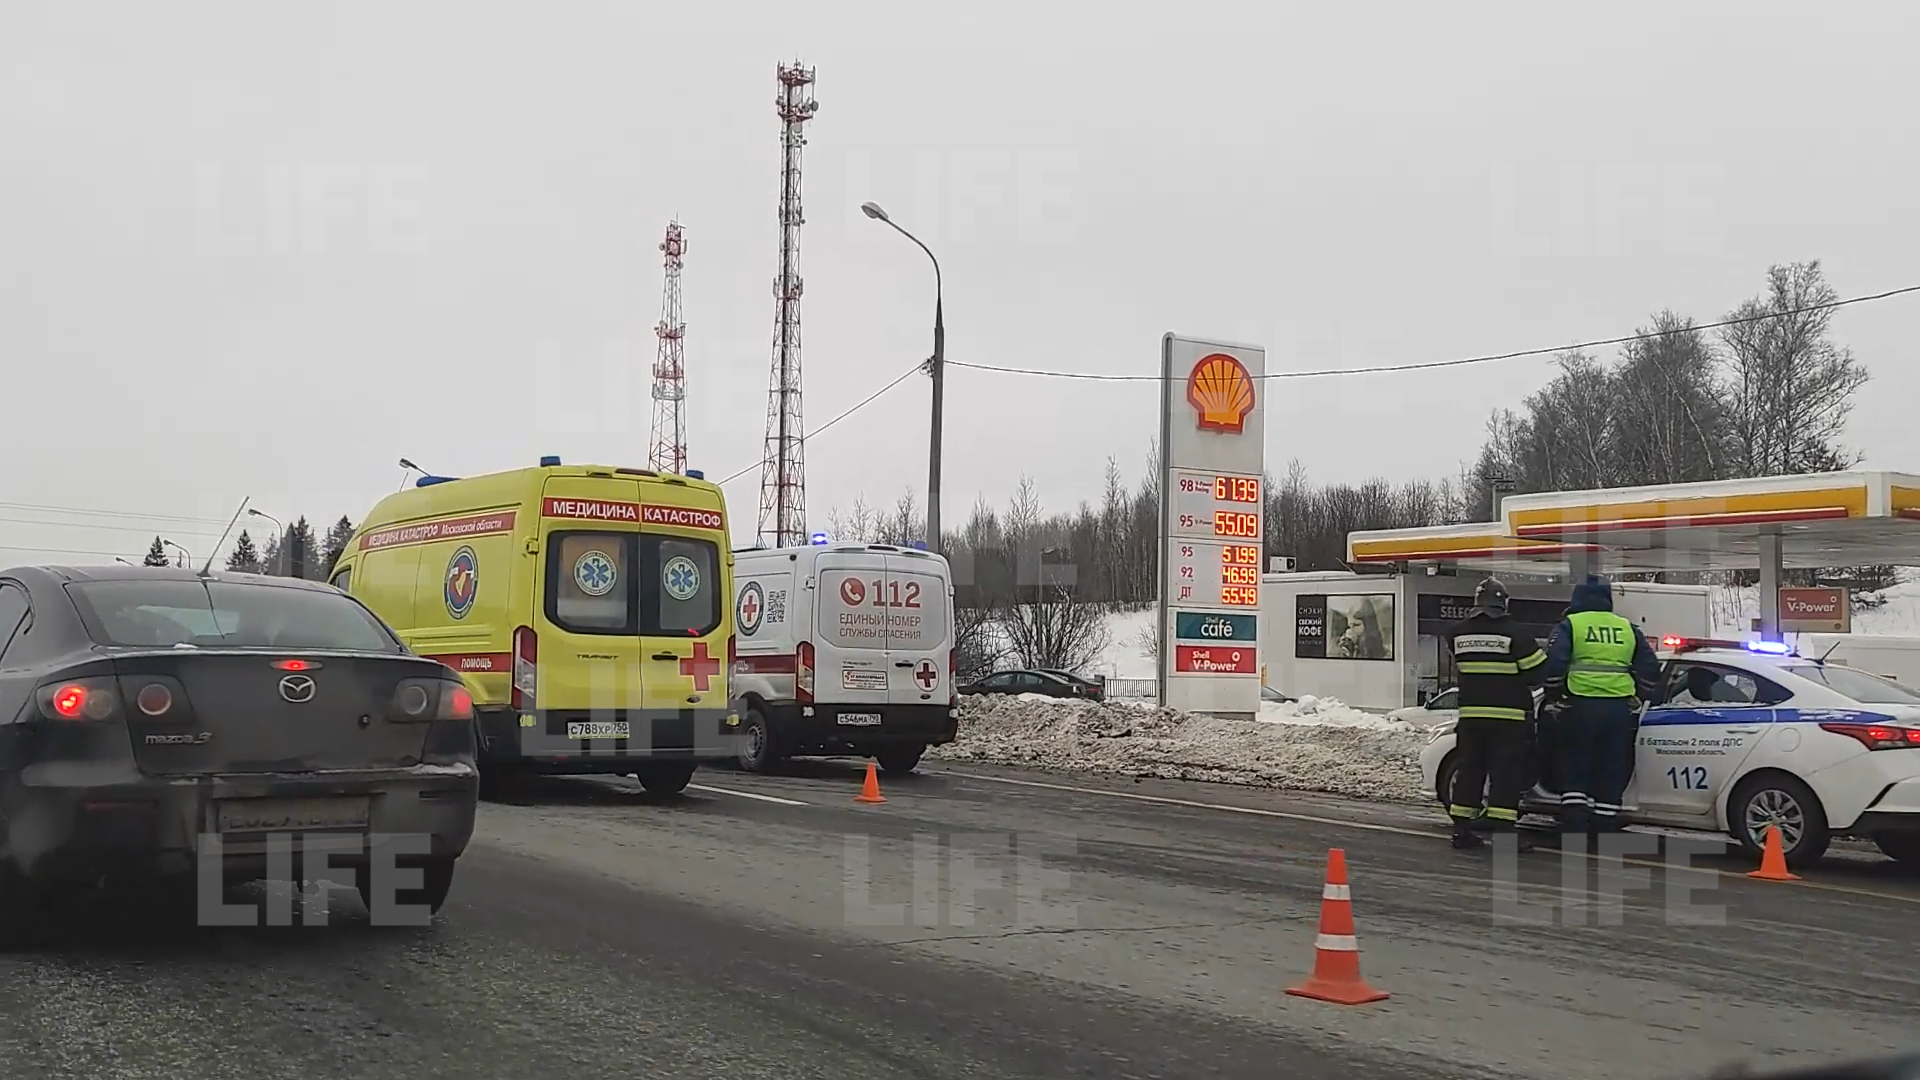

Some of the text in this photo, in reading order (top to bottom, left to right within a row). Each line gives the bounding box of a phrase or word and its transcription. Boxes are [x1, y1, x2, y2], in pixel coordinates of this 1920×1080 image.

[1180, 479, 1194, 492] 98
[552, 499, 721, 528] МЕДИЦИНА КАТАСТРОФ
[1180, 515, 1194, 528] 95
[400, 525, 439, 542] КАТАСТРОФ
[441, 520, 476, 536] Московской
[476, 518, 503, 532] области
[1181, 546, 1194, 557] 95
[1181, 567, 1193, 578] 92
[872, 579, 921, 608] 112
[1180, 586, 1192, 600] ДТ
[1298, 607, 1323, 615] СНЭКИ
[1787, 601, 1835, 612] V-Power
[839, 612, 921, 627] ЕДИНЫЙ НОМЕР
[1206, 616, 1219, 624] Shell
[1298, 617, 1323, 626] СВЕЖИЙ
[839, 628, 921, 640] СЛУЖБЫ СПАСЕНИЯ
[1201, 619, 1233, 637] café
[1298, 626, 1322, 636] КОФЕ
[1585, 625, 1625, 646] ДПС
[1192, 650, 1210, 659] Shell
[461, 656, 492, 671] ПОМОЩЬ
[1193, 659, 1237, 672] V-Power
[612, 722, 628, 732] 750
[1646, 737, 1690, 746] батальон
[1691, 738, 1697, 746] 2
[1699, 738, 1721, 746] полк
[1722, 738, 1743, 748] ДПС
[1697, 748, 1727, 756] область
[1667, 766, 1708, 790] 112
